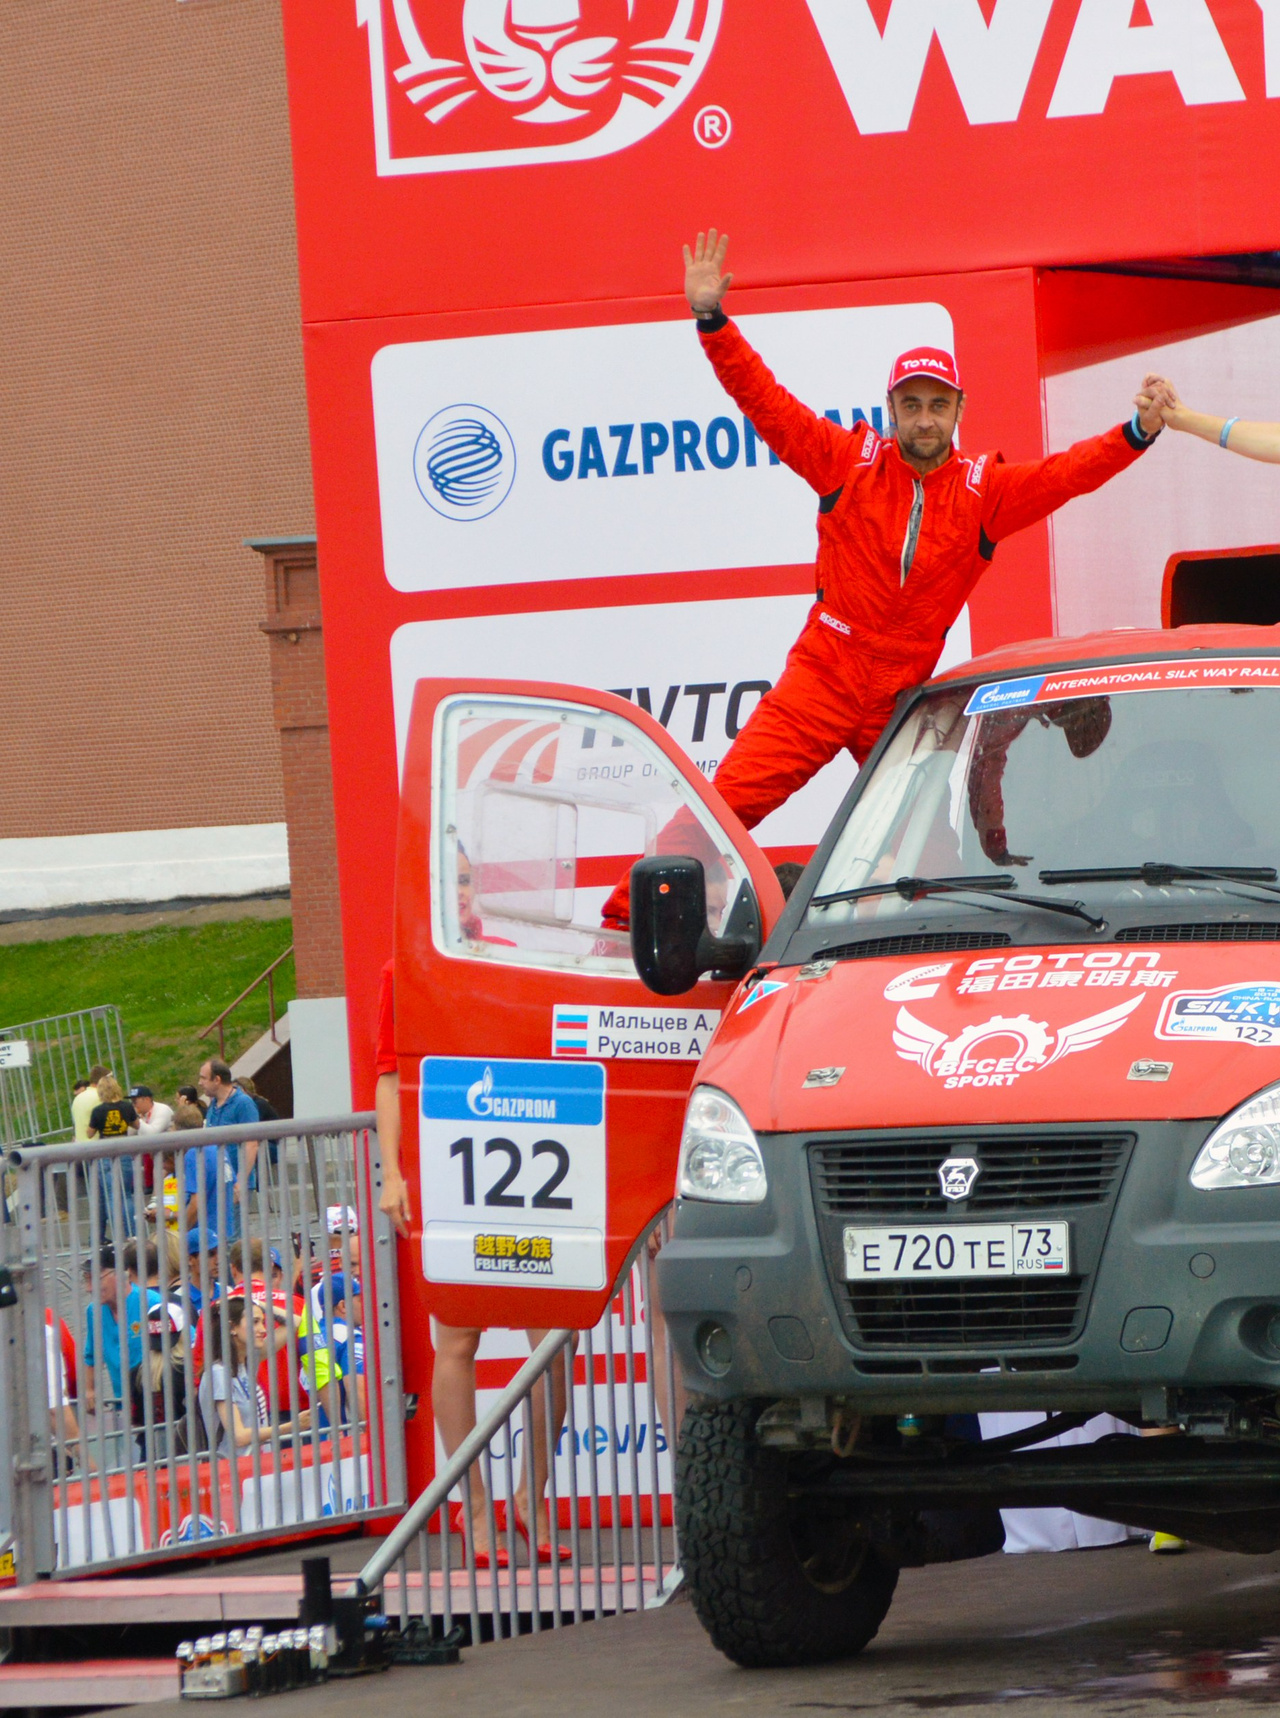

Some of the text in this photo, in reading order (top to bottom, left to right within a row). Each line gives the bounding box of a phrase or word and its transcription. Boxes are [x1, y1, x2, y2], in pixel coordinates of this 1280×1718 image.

[901, 358, 948, 371] TOTAL
[1045, 672, 1162, 692] INTERNATIONAL
[1165, 669, 1199, 680] SILK
[1203, 667, 1238, 678] WAY
[966, 952, 1161, 976] FOTON
[956, 970, 1179, 995] 福田康明斯
[1182, 1000, 1264, 1015] SILK
[599, 1010, 714, 1033] Мальцев А.
[1235, 1026, 1274, 1043] 122
[597, 1035, 681, 1058] Русанов
[937, 1057, 1038, 1077] BFCEC
[944, 1073, 1020, 1089] SPORT
[492, 1097, 556, 1119] GAZPROM
[449, 1137, 574, 1211] 122
[1017, 1228, 1052, 1257] 73
[475, 1257, 552, 1275] FBLIFE.COM
[1016, 1258, 1043, 1270] RUS
